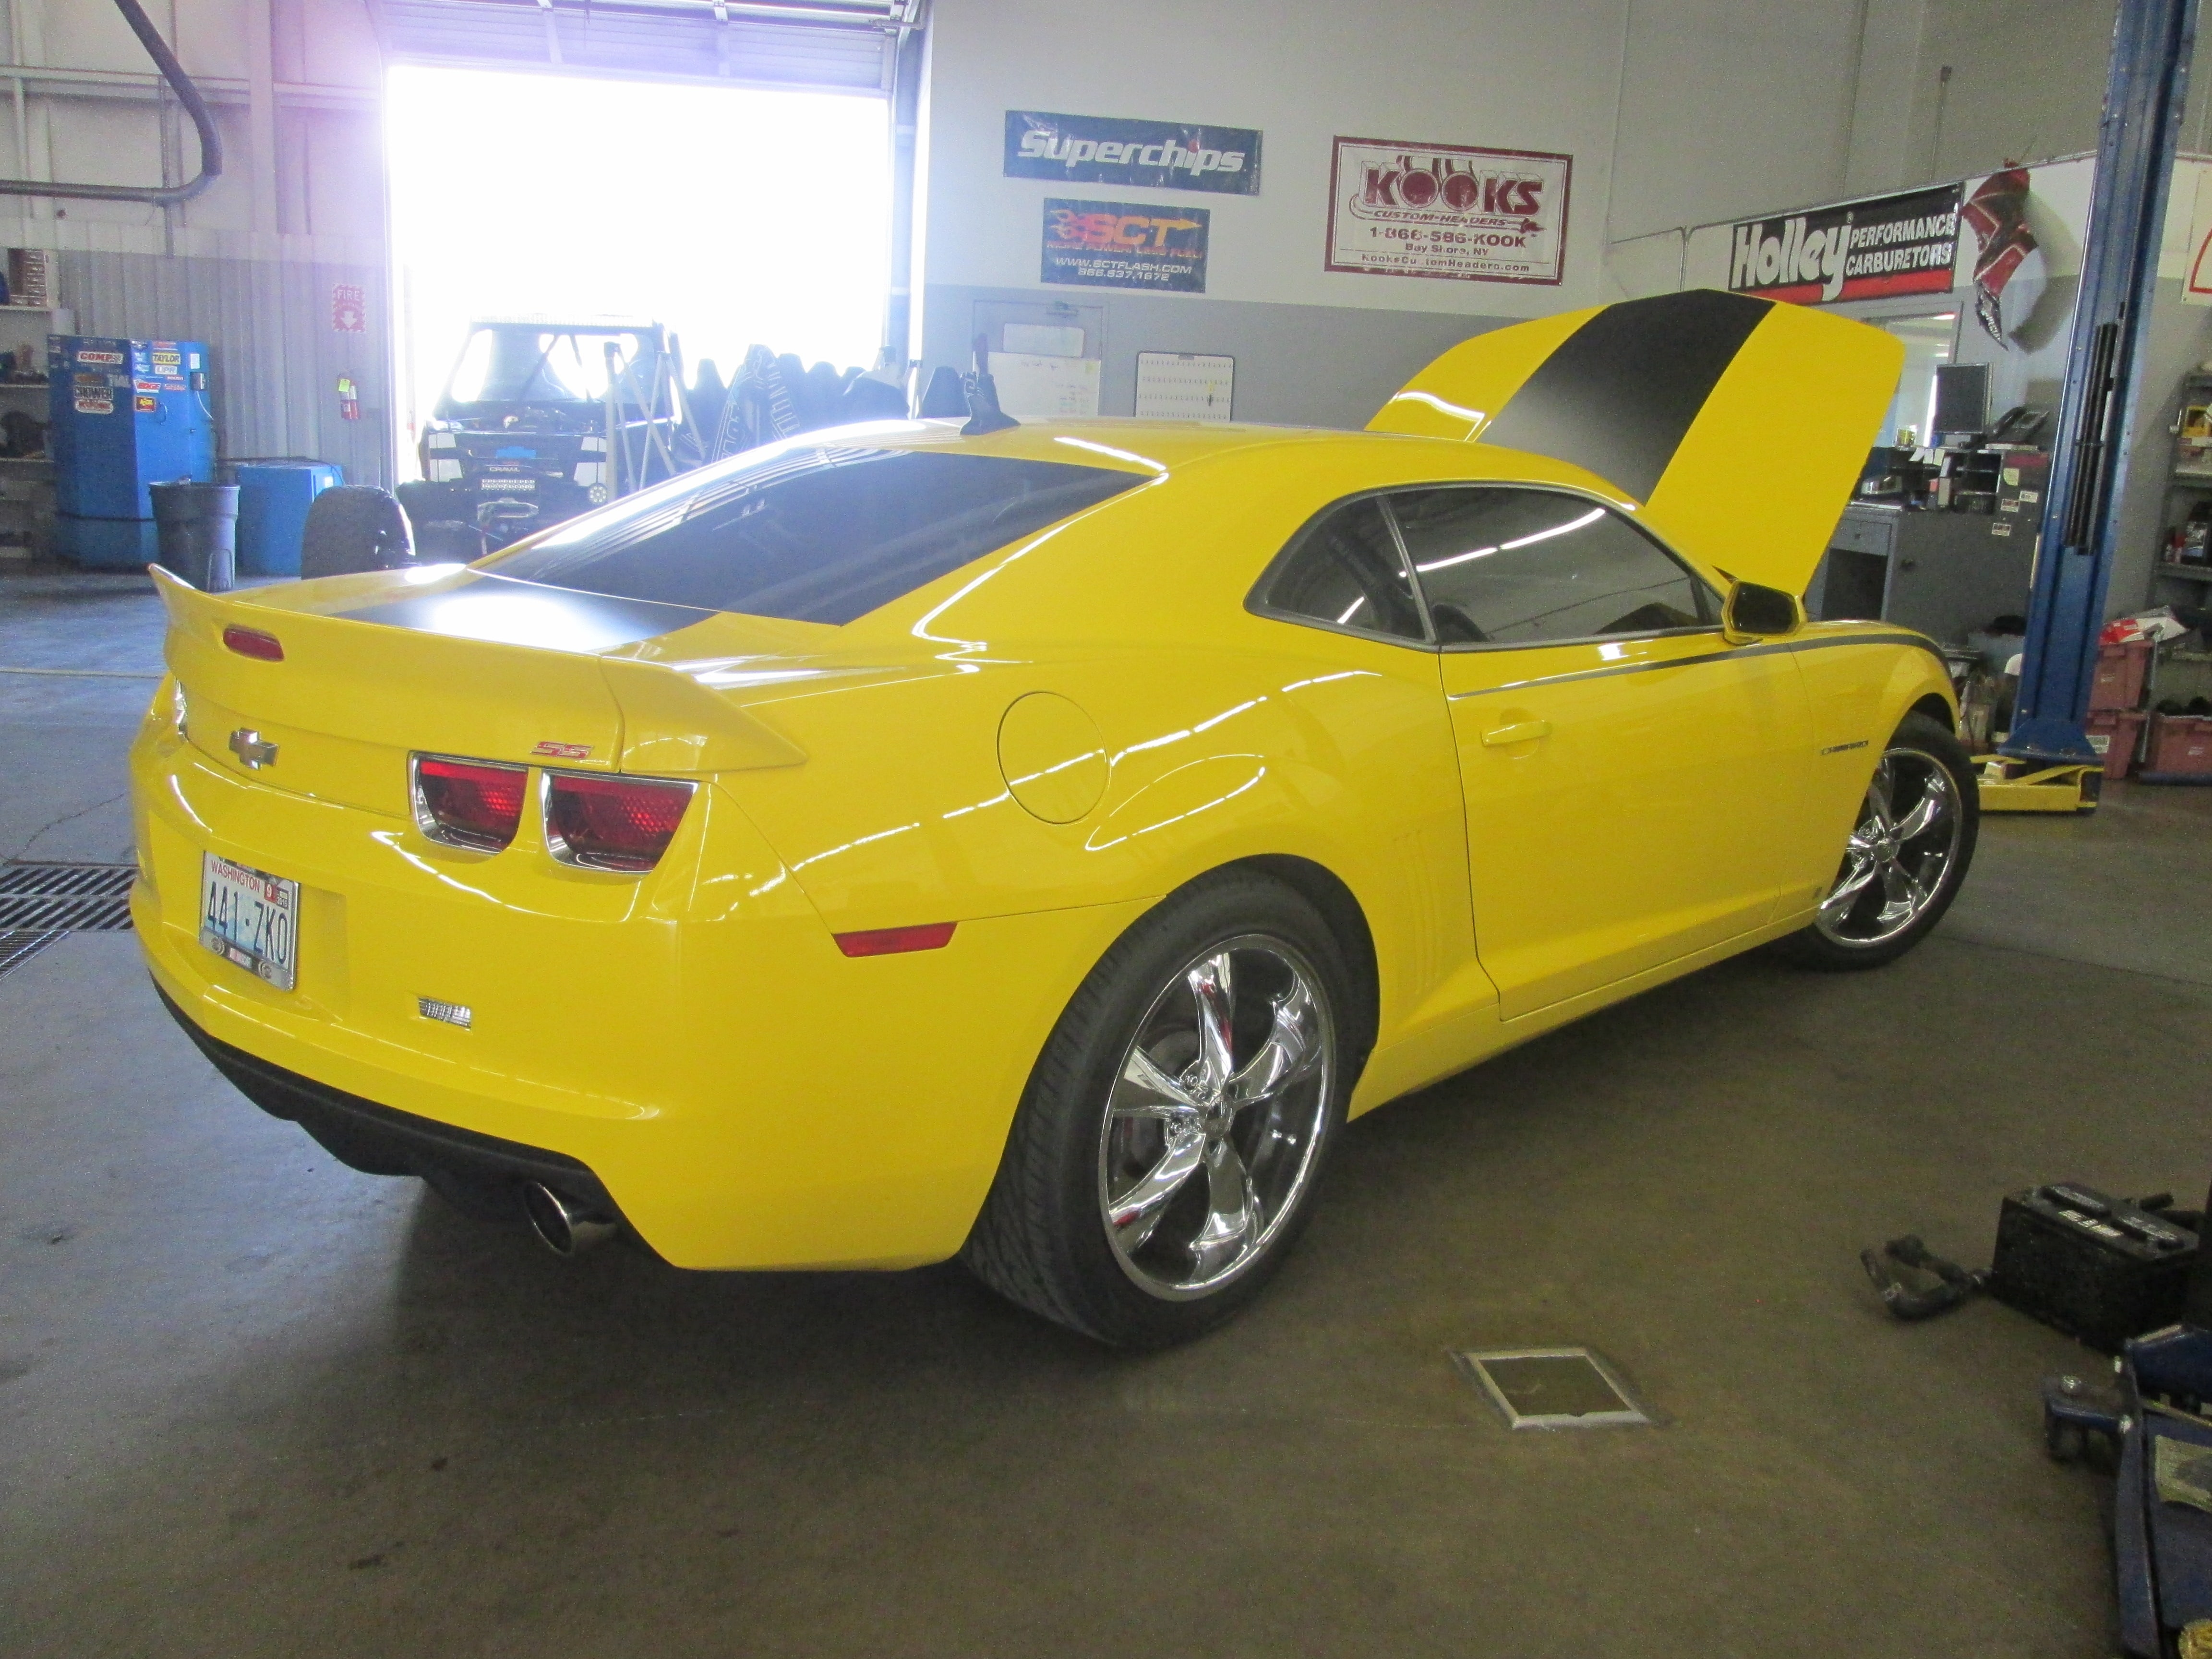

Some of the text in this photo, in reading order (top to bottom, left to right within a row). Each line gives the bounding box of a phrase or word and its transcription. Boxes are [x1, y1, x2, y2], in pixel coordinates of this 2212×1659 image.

[1017, 130, 1245, 176] Superchips
[1360, 156, 1544, 216] KOOKS
[1373, 210, 1507, 227] CUSTOM-HEADERS
[1082, 213, 1202, 247] SCT
[1851, 212, 1955, 248] PERFORMANCE
[1405, 243, 1428, 254] Bay
[1473, 248, 1490, 256] NY
[1731, 216, 1852, 301] Holley
[1846, 242, 1953, 276] CARBURETORS
[1056, 257, 1192, 274] WWW.SCTFLASH.COM
[1361, 253, 1530, 272] KooksCutomHeaders.com
[337, 289, 360, 301] FIRE
[153, 354, 180, 362] TAYLOR
[530, 741, 594, 759] SS
[211, 860, 261, 893] WASHINGTON
[266, 884, 273, 898] 9
